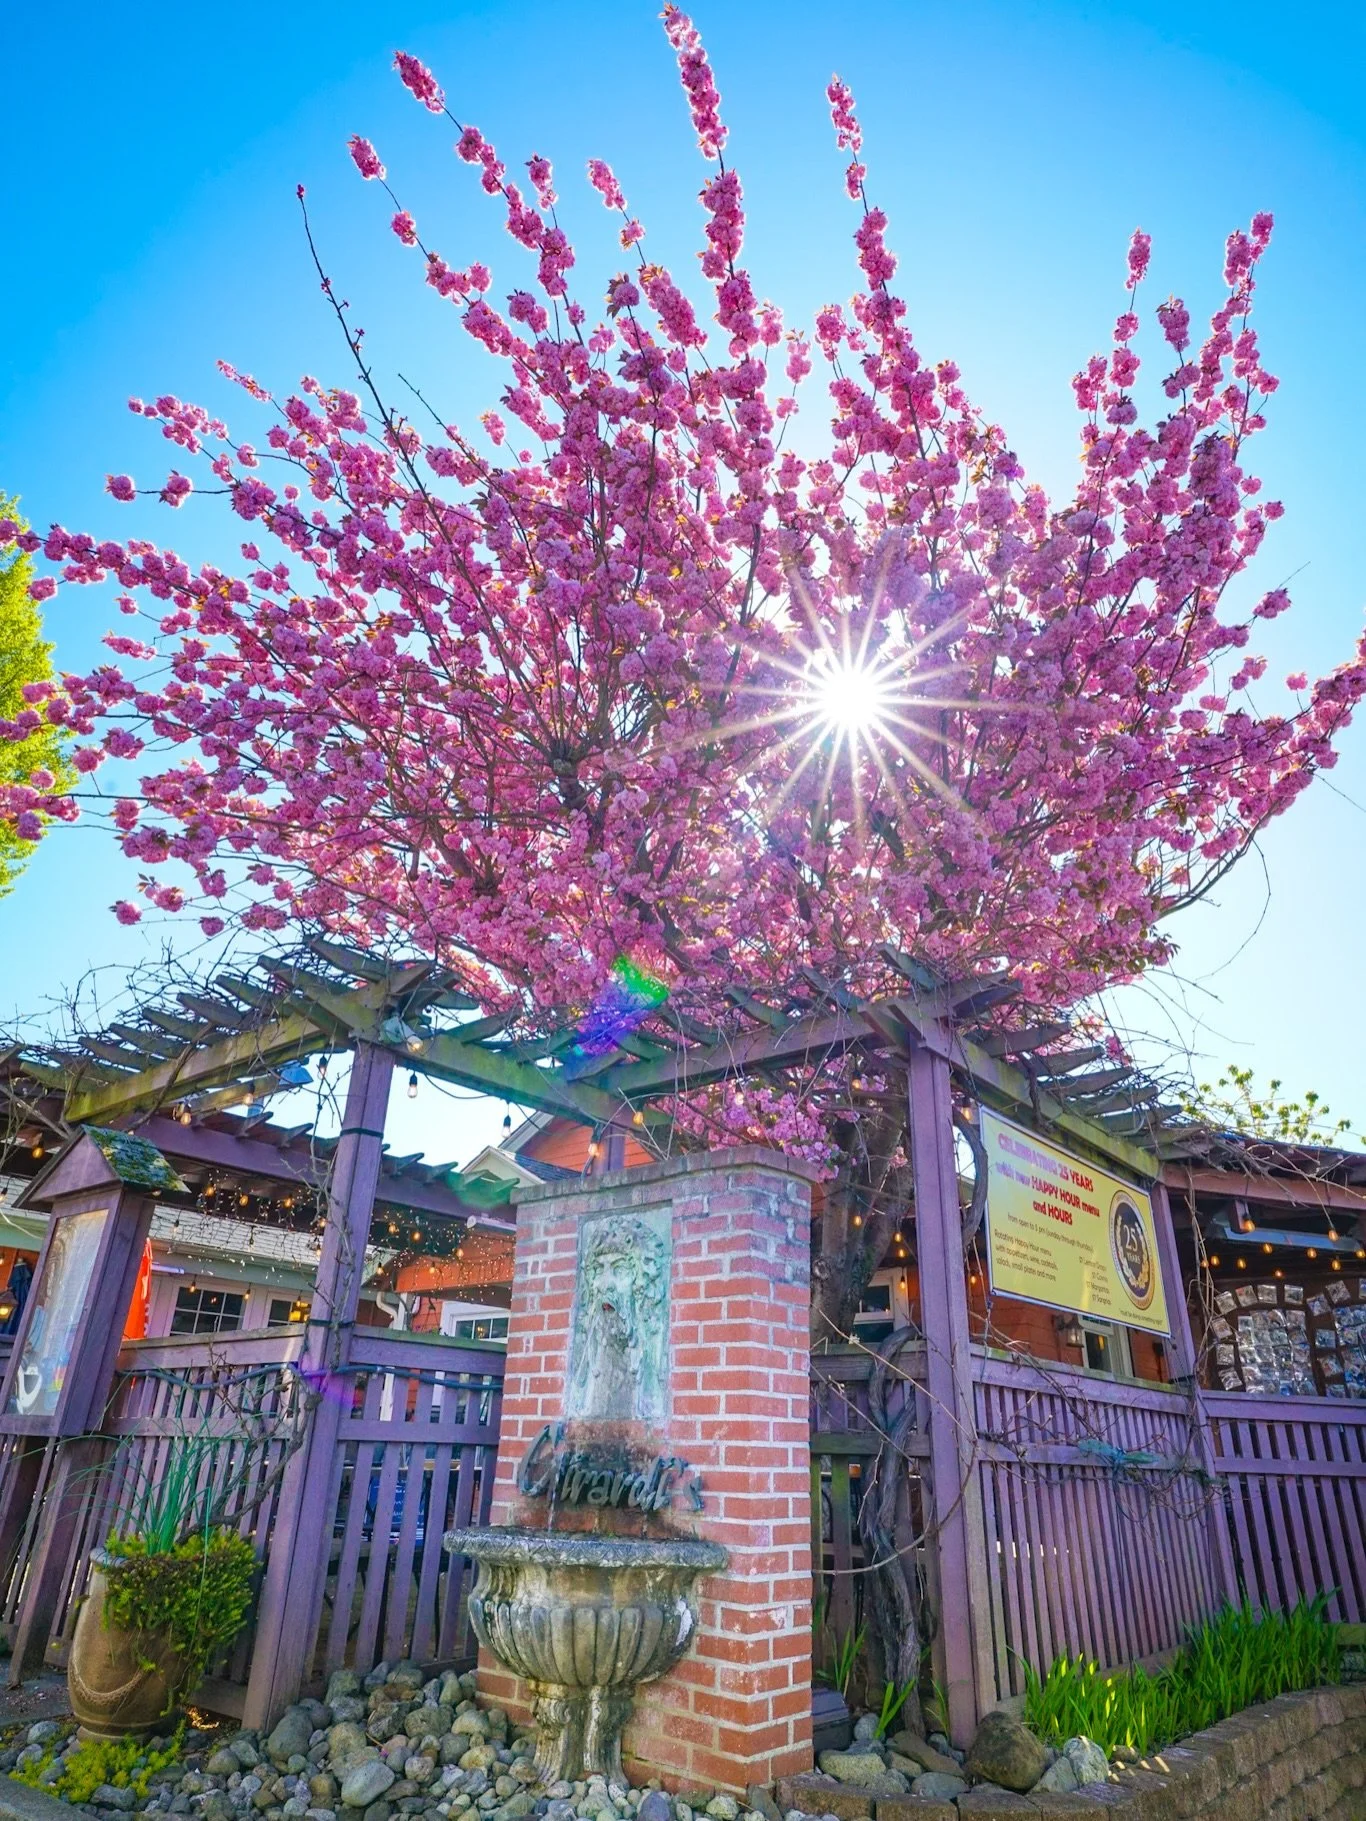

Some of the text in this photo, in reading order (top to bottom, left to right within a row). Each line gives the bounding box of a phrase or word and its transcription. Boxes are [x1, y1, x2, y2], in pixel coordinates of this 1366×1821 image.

[998, 1133, 1094, 1193] CELEBRATING 25 YEARS
[1032, 1175, 1058, 1199] HAPPY
[1059, 1188, 1081, 1210] HOUR
[1082, 1202, 1100, 1218] menu
[1033, 1200, 1073, 1226] and HOURS
[1014, 1235, 1029, 1250] Happy
[1123, 1224, 1138, 1253] 25
